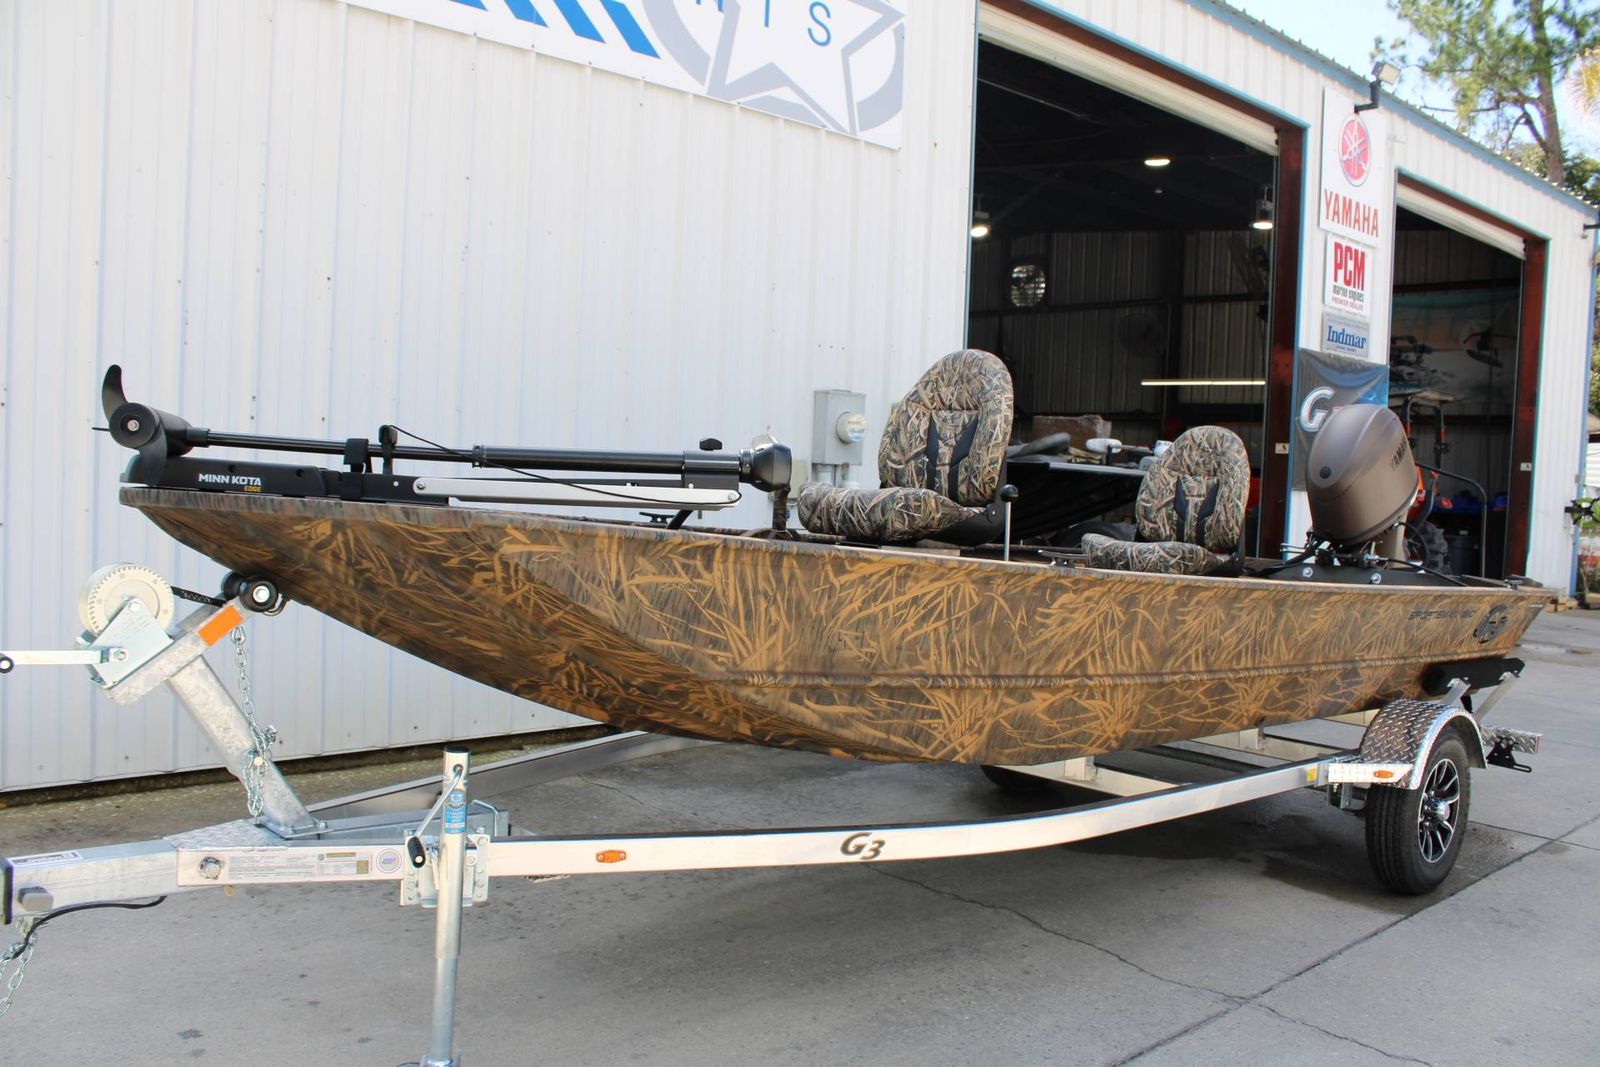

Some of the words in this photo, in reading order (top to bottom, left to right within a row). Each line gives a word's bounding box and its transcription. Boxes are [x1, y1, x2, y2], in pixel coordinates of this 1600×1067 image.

[1324, 188, 1379, 238] YAMAHA
[1333, 241, 1366, 291] PCM
[1327, 325, 1367, 349] Indmar
[198, 473, 230, 484] MINN
[231, 475, 262, 486] KOTA
[840, 831, 886, 860] G3
